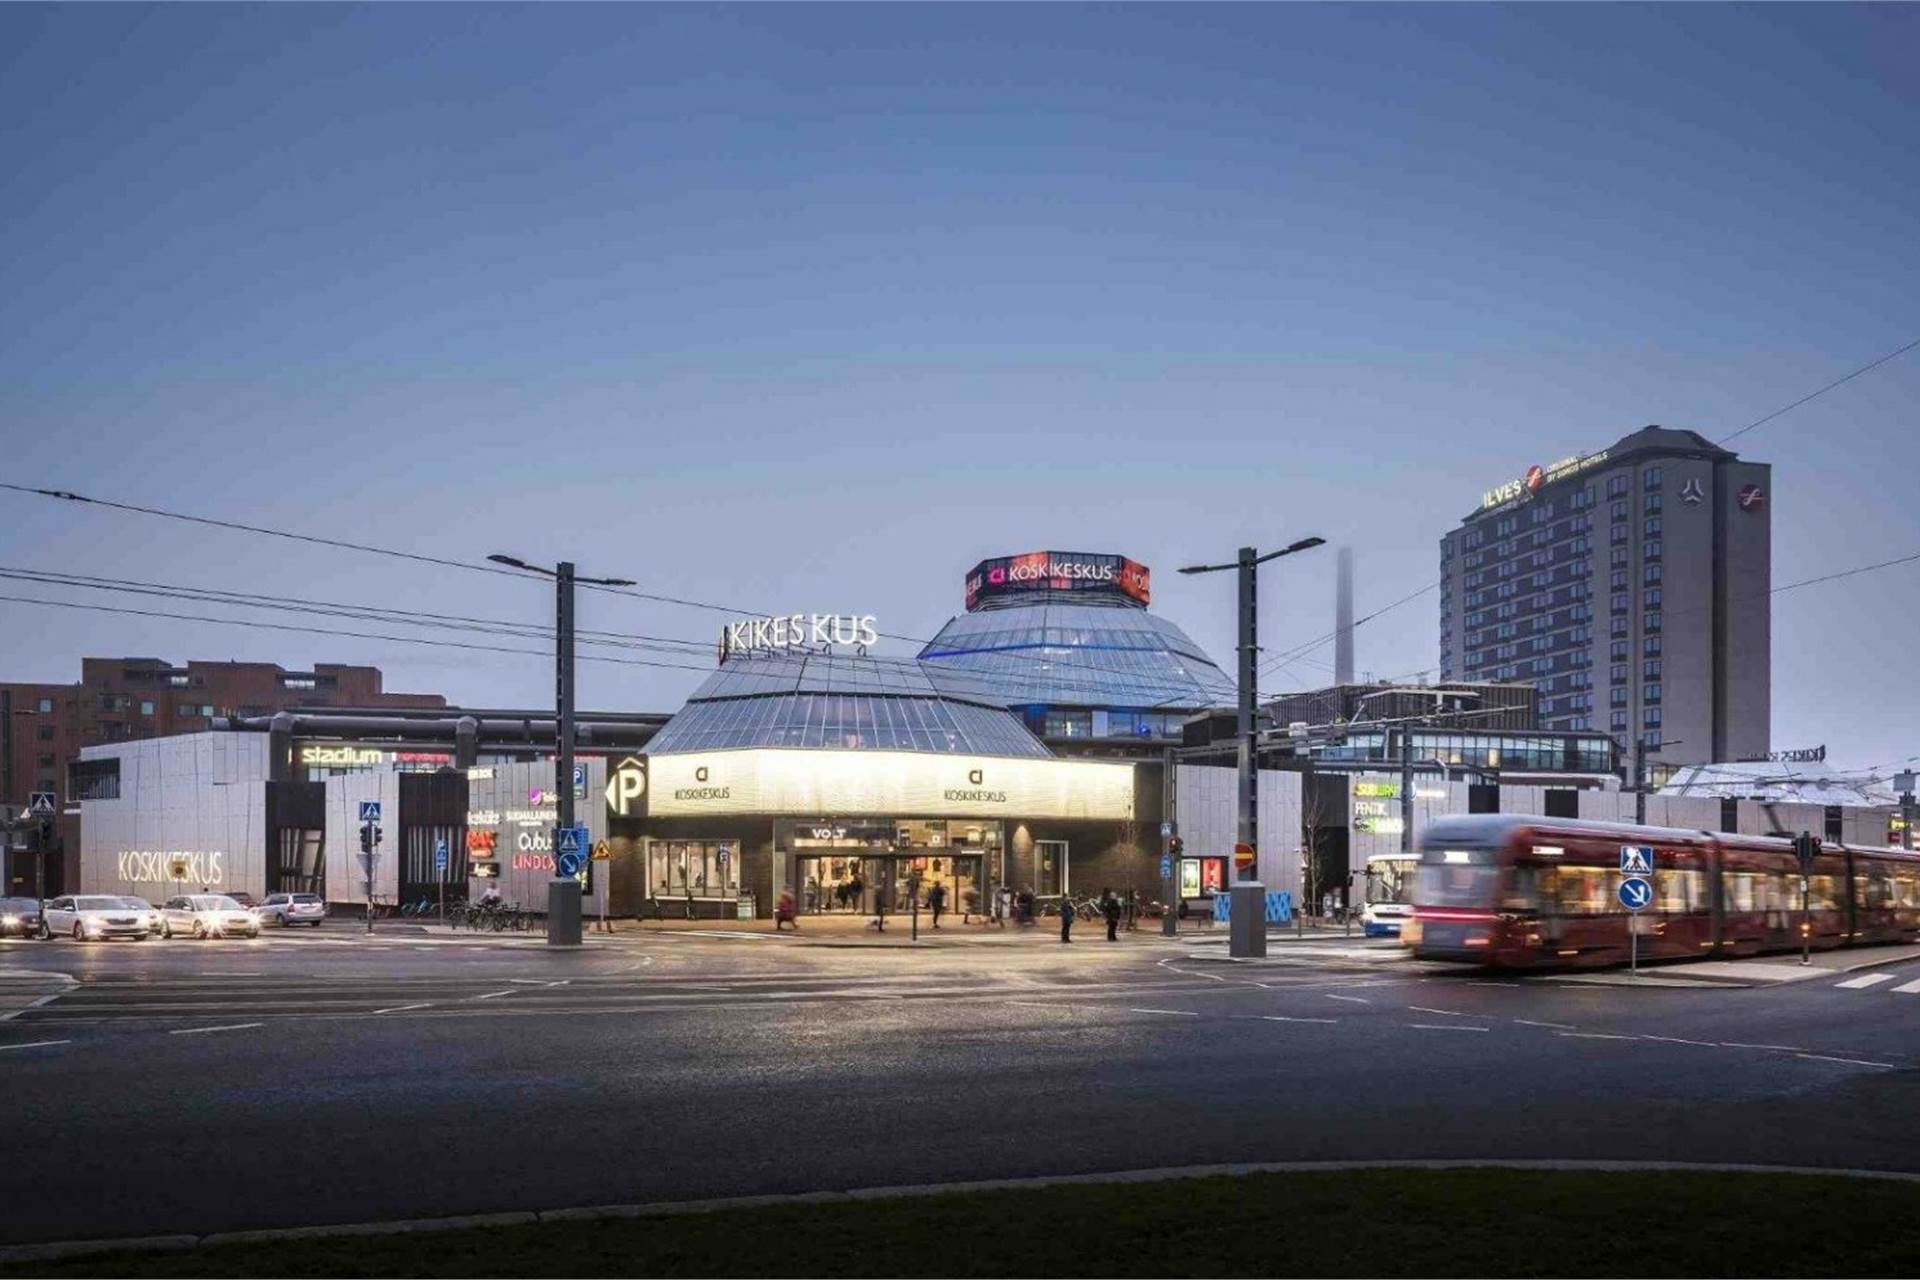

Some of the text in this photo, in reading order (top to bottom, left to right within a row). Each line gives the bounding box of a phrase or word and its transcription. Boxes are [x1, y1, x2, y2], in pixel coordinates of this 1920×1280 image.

[1483, 479, 1522, 508] ILVES
[812, 613, 879, 646] KUS
[302, 746, 382, 764] stadium
[675, 787, 730, 801] KOSKIKESKUS
[944, 789, 1007, 802] KOSKIKESKUS
[812, 828, 847, 840] VOLT
[118, 851, 222, 885] KOSKIKESKUS
